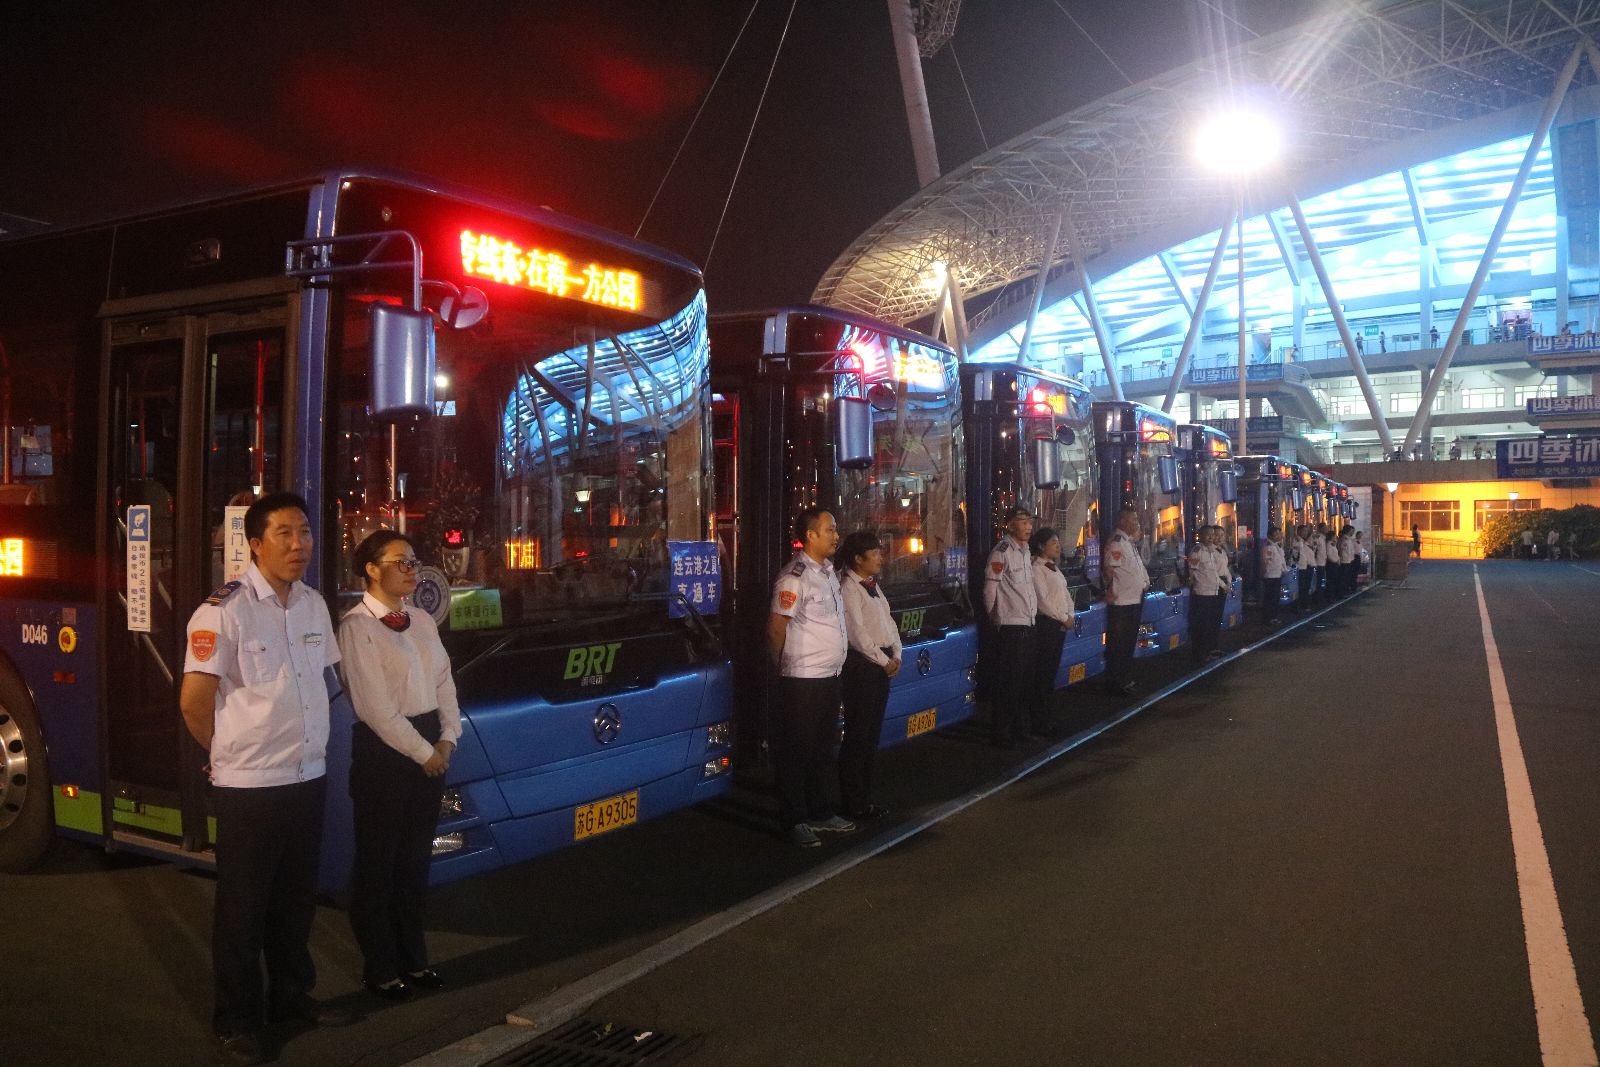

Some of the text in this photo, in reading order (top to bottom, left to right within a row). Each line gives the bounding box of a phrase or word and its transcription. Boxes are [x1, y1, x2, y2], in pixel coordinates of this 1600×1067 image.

[673, 555, 718, 577] 连云港之夏
[900, 609, 927, 633] BRT
[22, 623, 48, 645] D046
[563, 642, 622, 681] BRT
